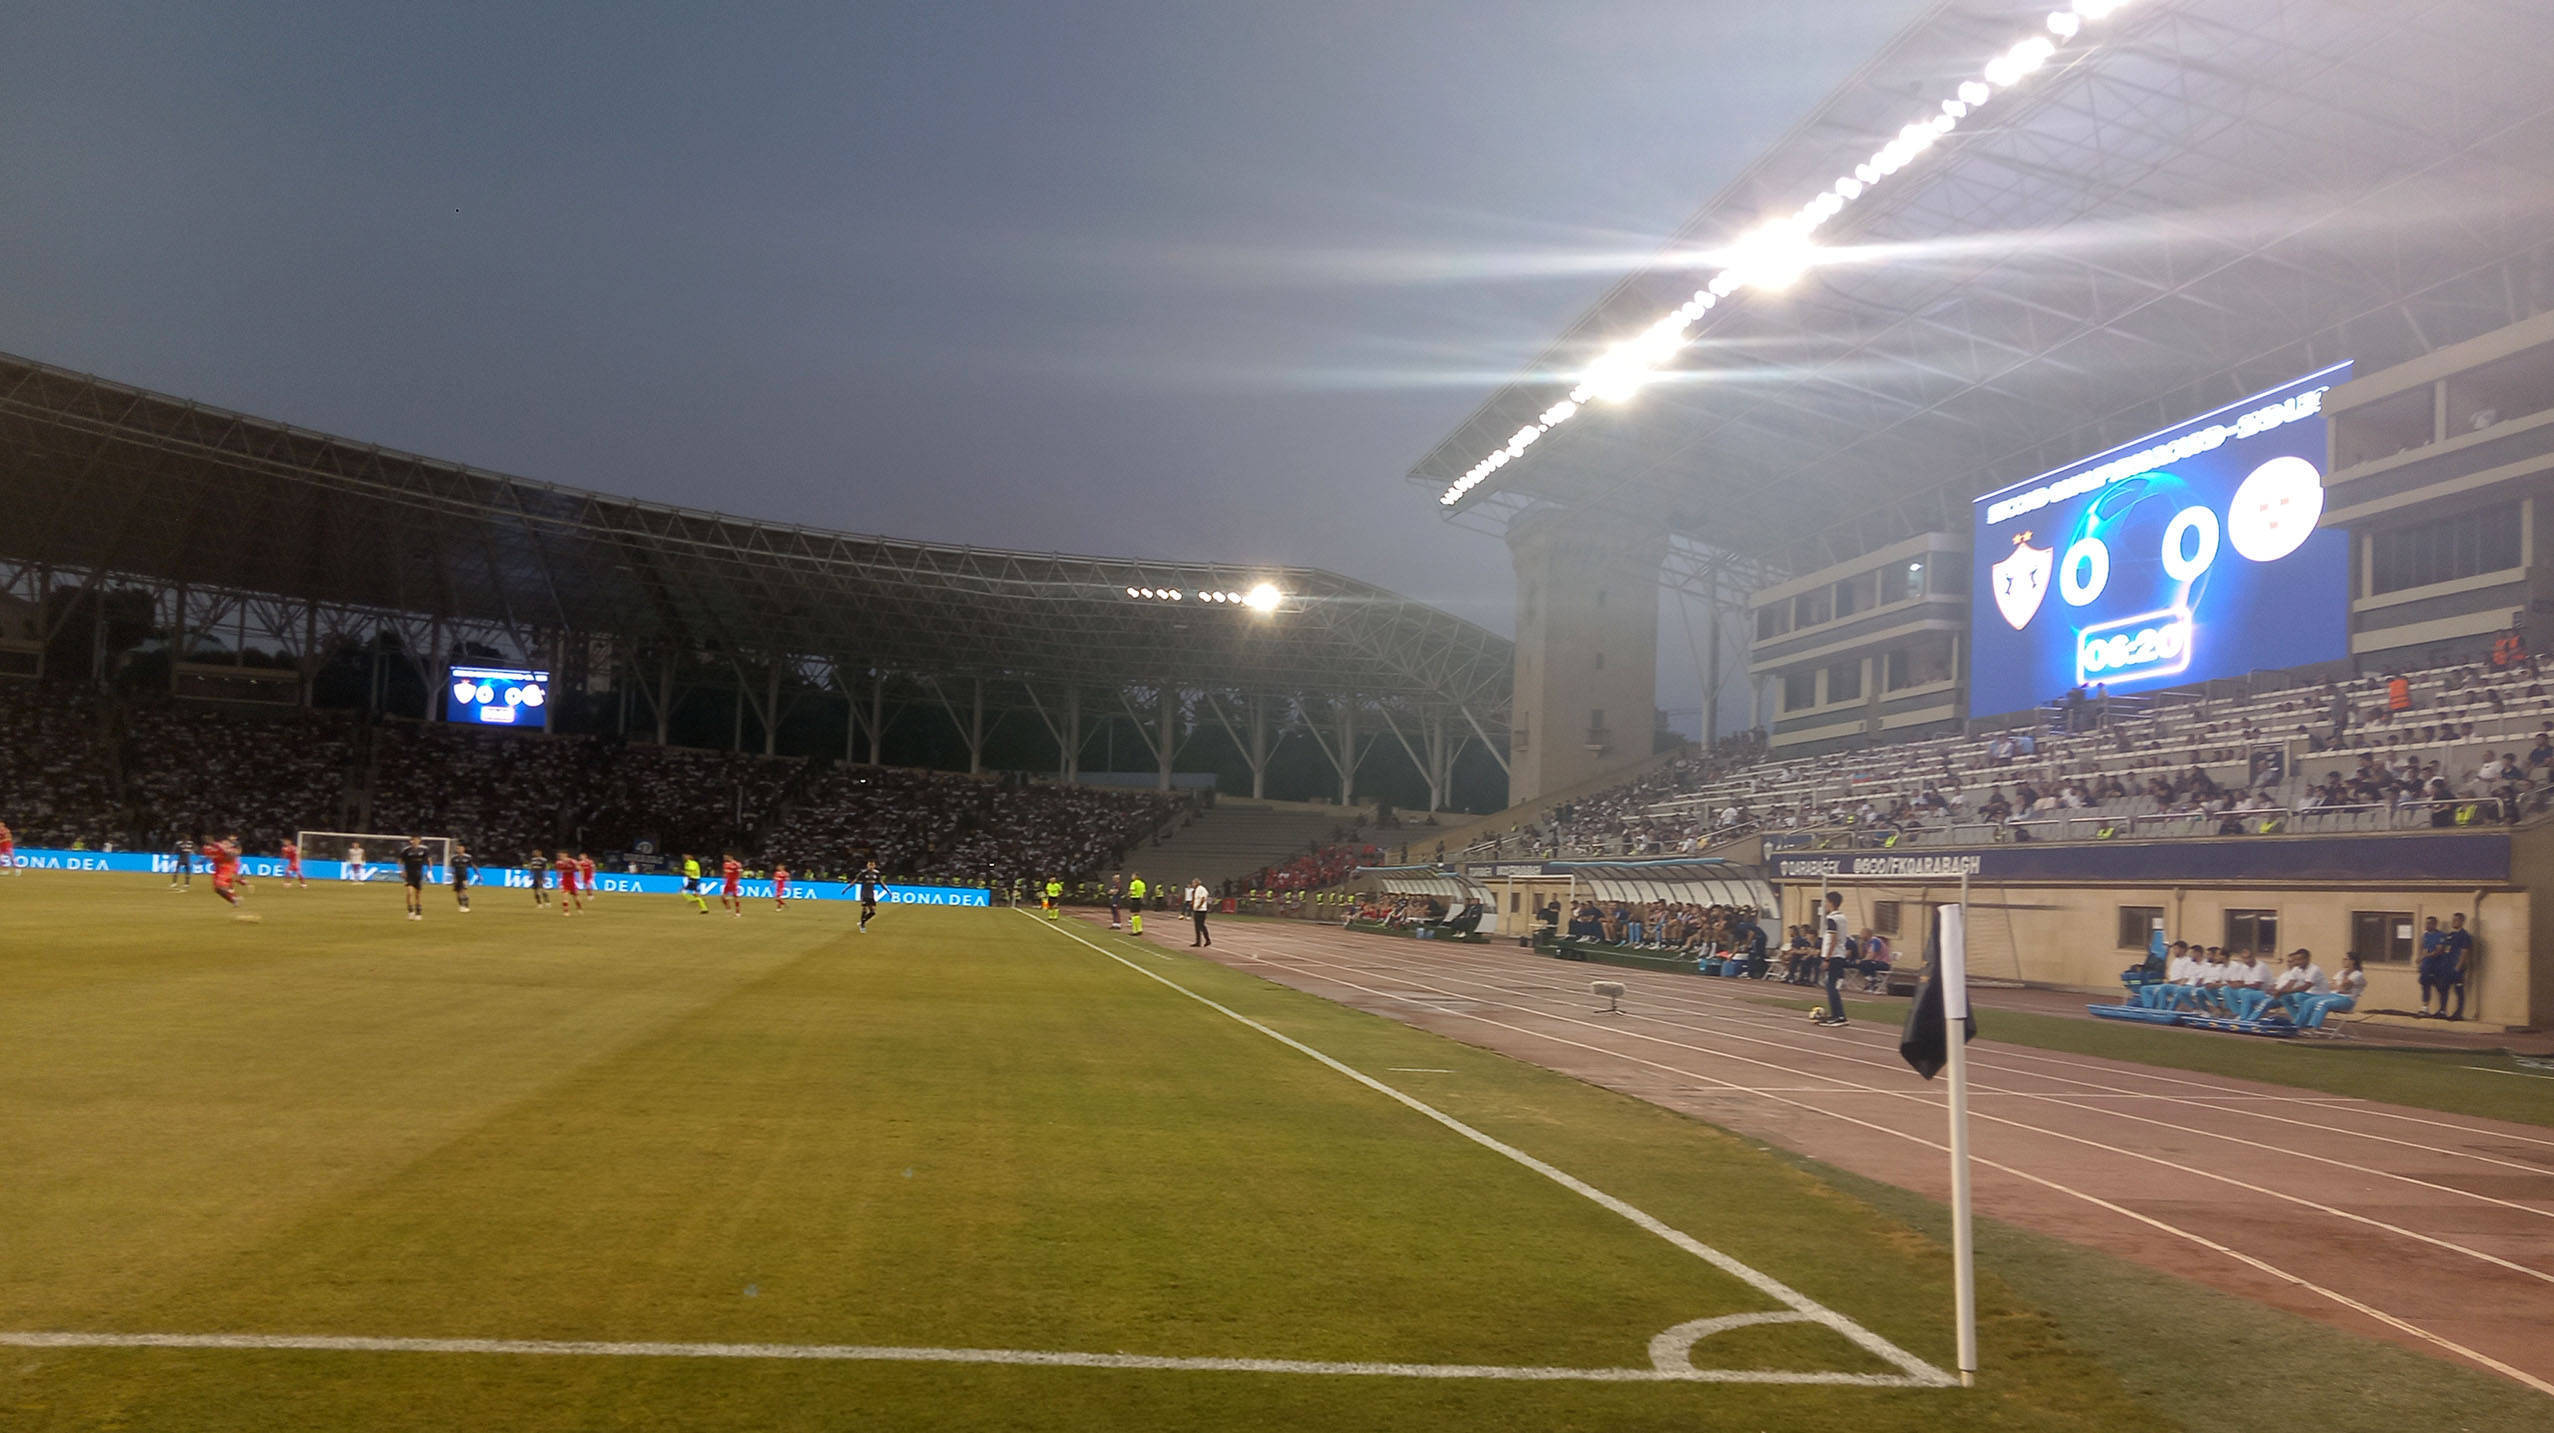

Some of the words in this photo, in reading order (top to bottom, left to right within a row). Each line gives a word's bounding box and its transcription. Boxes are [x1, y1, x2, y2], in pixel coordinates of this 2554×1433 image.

[2060, 537, 2110, 606] 0
[2162, 506, 2220, 582] 0
[66, 857, 109, 871] DEA
[604, 879, 643, 892] DEA
[891, 892, 944, 905] BONA
[949, 894, 986, 907] DEA
